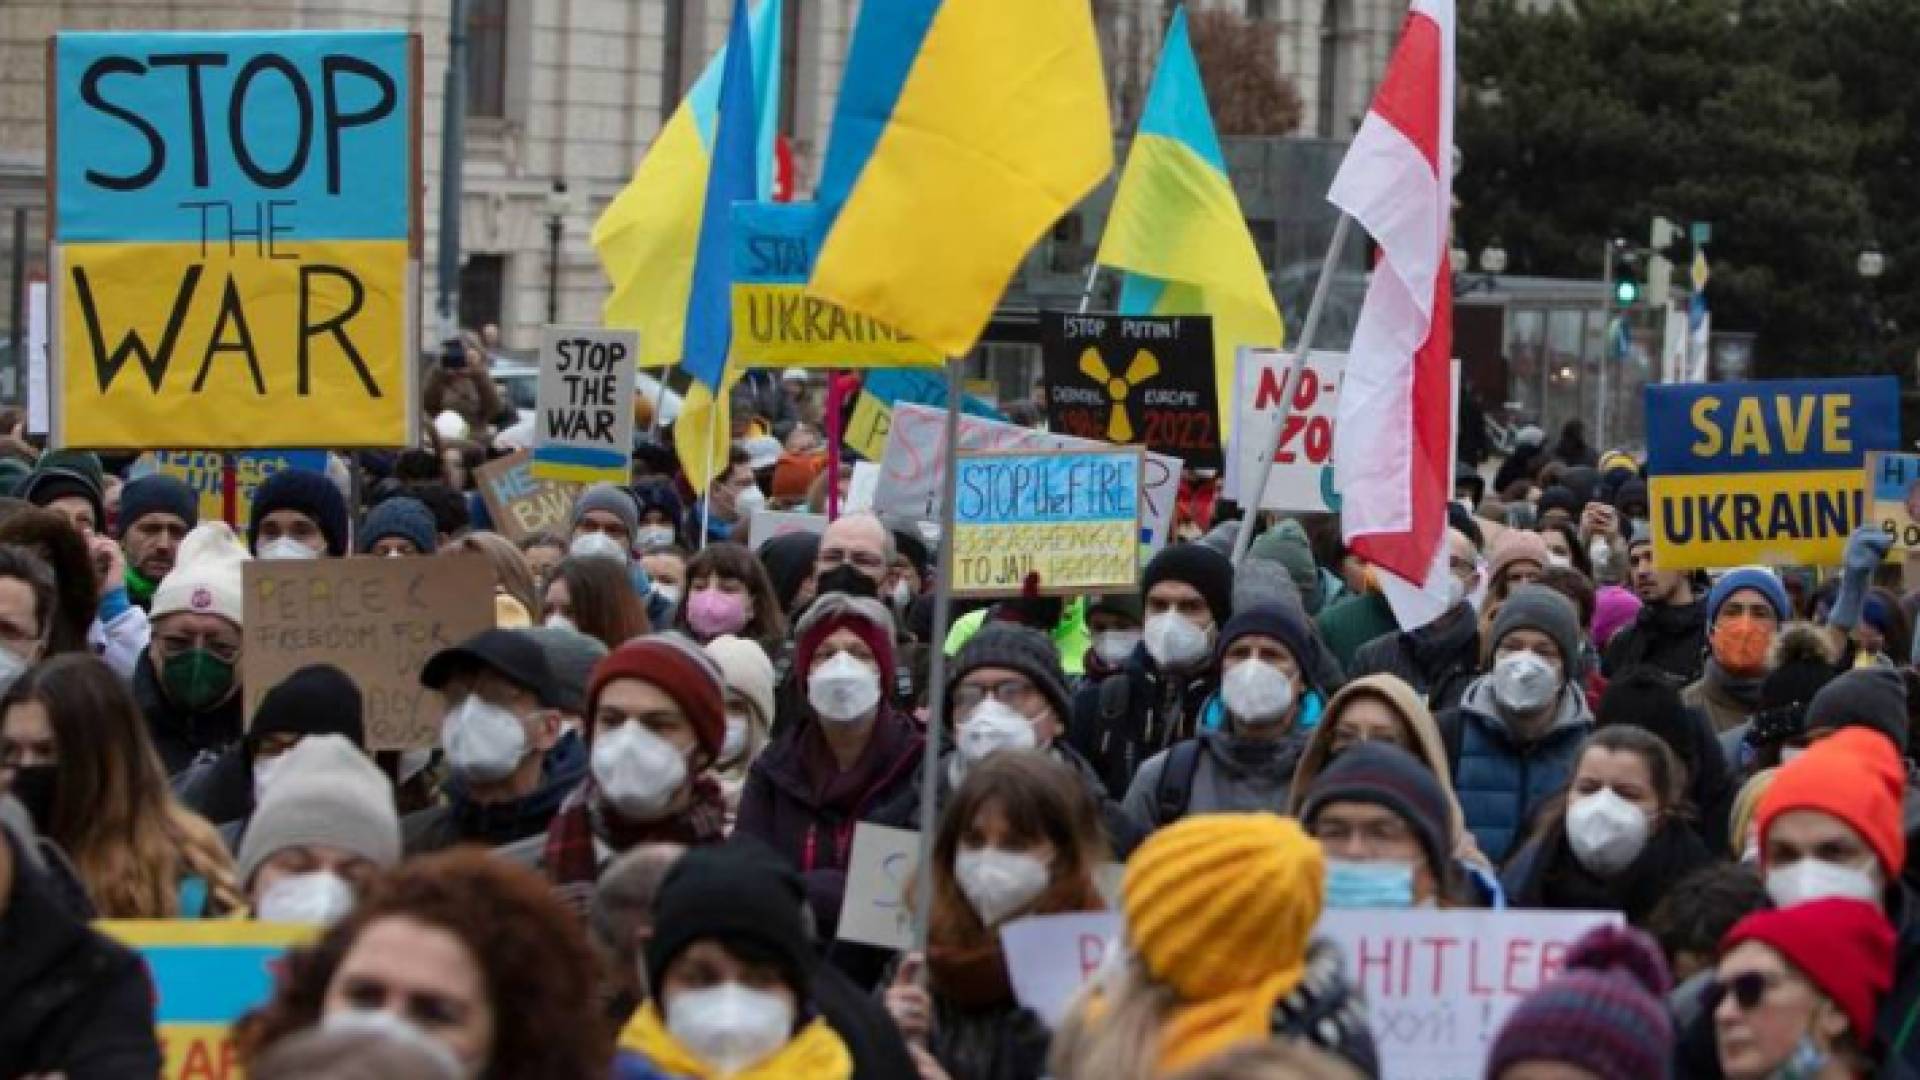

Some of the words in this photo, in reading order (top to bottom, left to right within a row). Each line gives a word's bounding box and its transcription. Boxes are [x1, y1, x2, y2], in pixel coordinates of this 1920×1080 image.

[80, 53, 397, 195] STOP
[178, 200, 299, 259] THE
[72, 265, 382, 398] WAR
[748, 294, 914, 343] UKRAIN
[556, 339, 626, 372] STOP
[562, 375, 617, 405] THE
[1254, 366, 1346, 411] NO-
[548, 408, 616, 444] WAR
[1144, 410, 1213, 448] 2022
[1272, 415, 1335, 464] ZO
[1690, 393, 1853, 457] SAVE
[960, 463, 1031, 518] STOP
[1068, 460, 1135, 515] FIRE
[959, 555, 992, 584] TO
[255, 574, 388, 620] PEACE
[1356, 936, 1568, 998] HITLER
